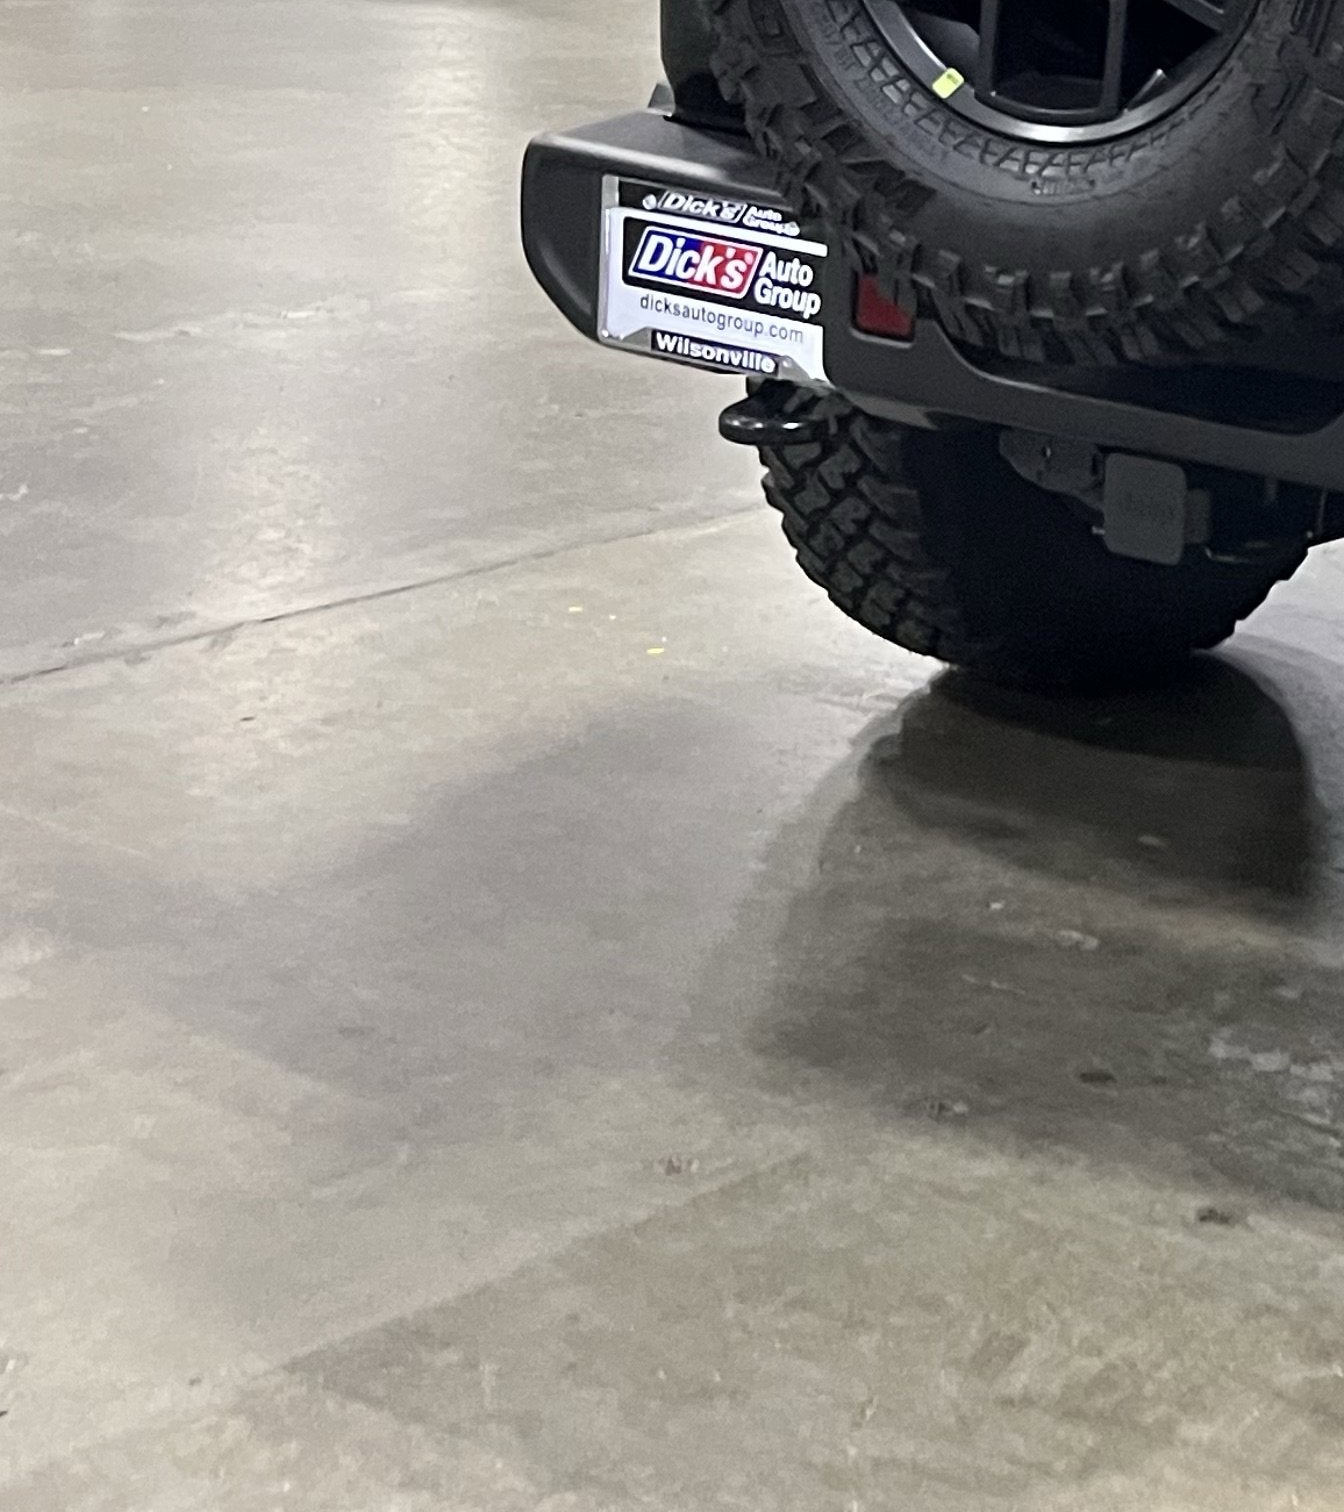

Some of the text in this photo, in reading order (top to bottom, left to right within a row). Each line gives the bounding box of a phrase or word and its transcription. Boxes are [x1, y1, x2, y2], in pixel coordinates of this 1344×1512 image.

[638, 234, 747, 289] Dick's
[759, 251, 814, 287] Auto
[640, 293, 805, 344] dicksautogroup.com
[754, 277, 822, 319] Group
[655, 332, 776, 373] Wilsonville
